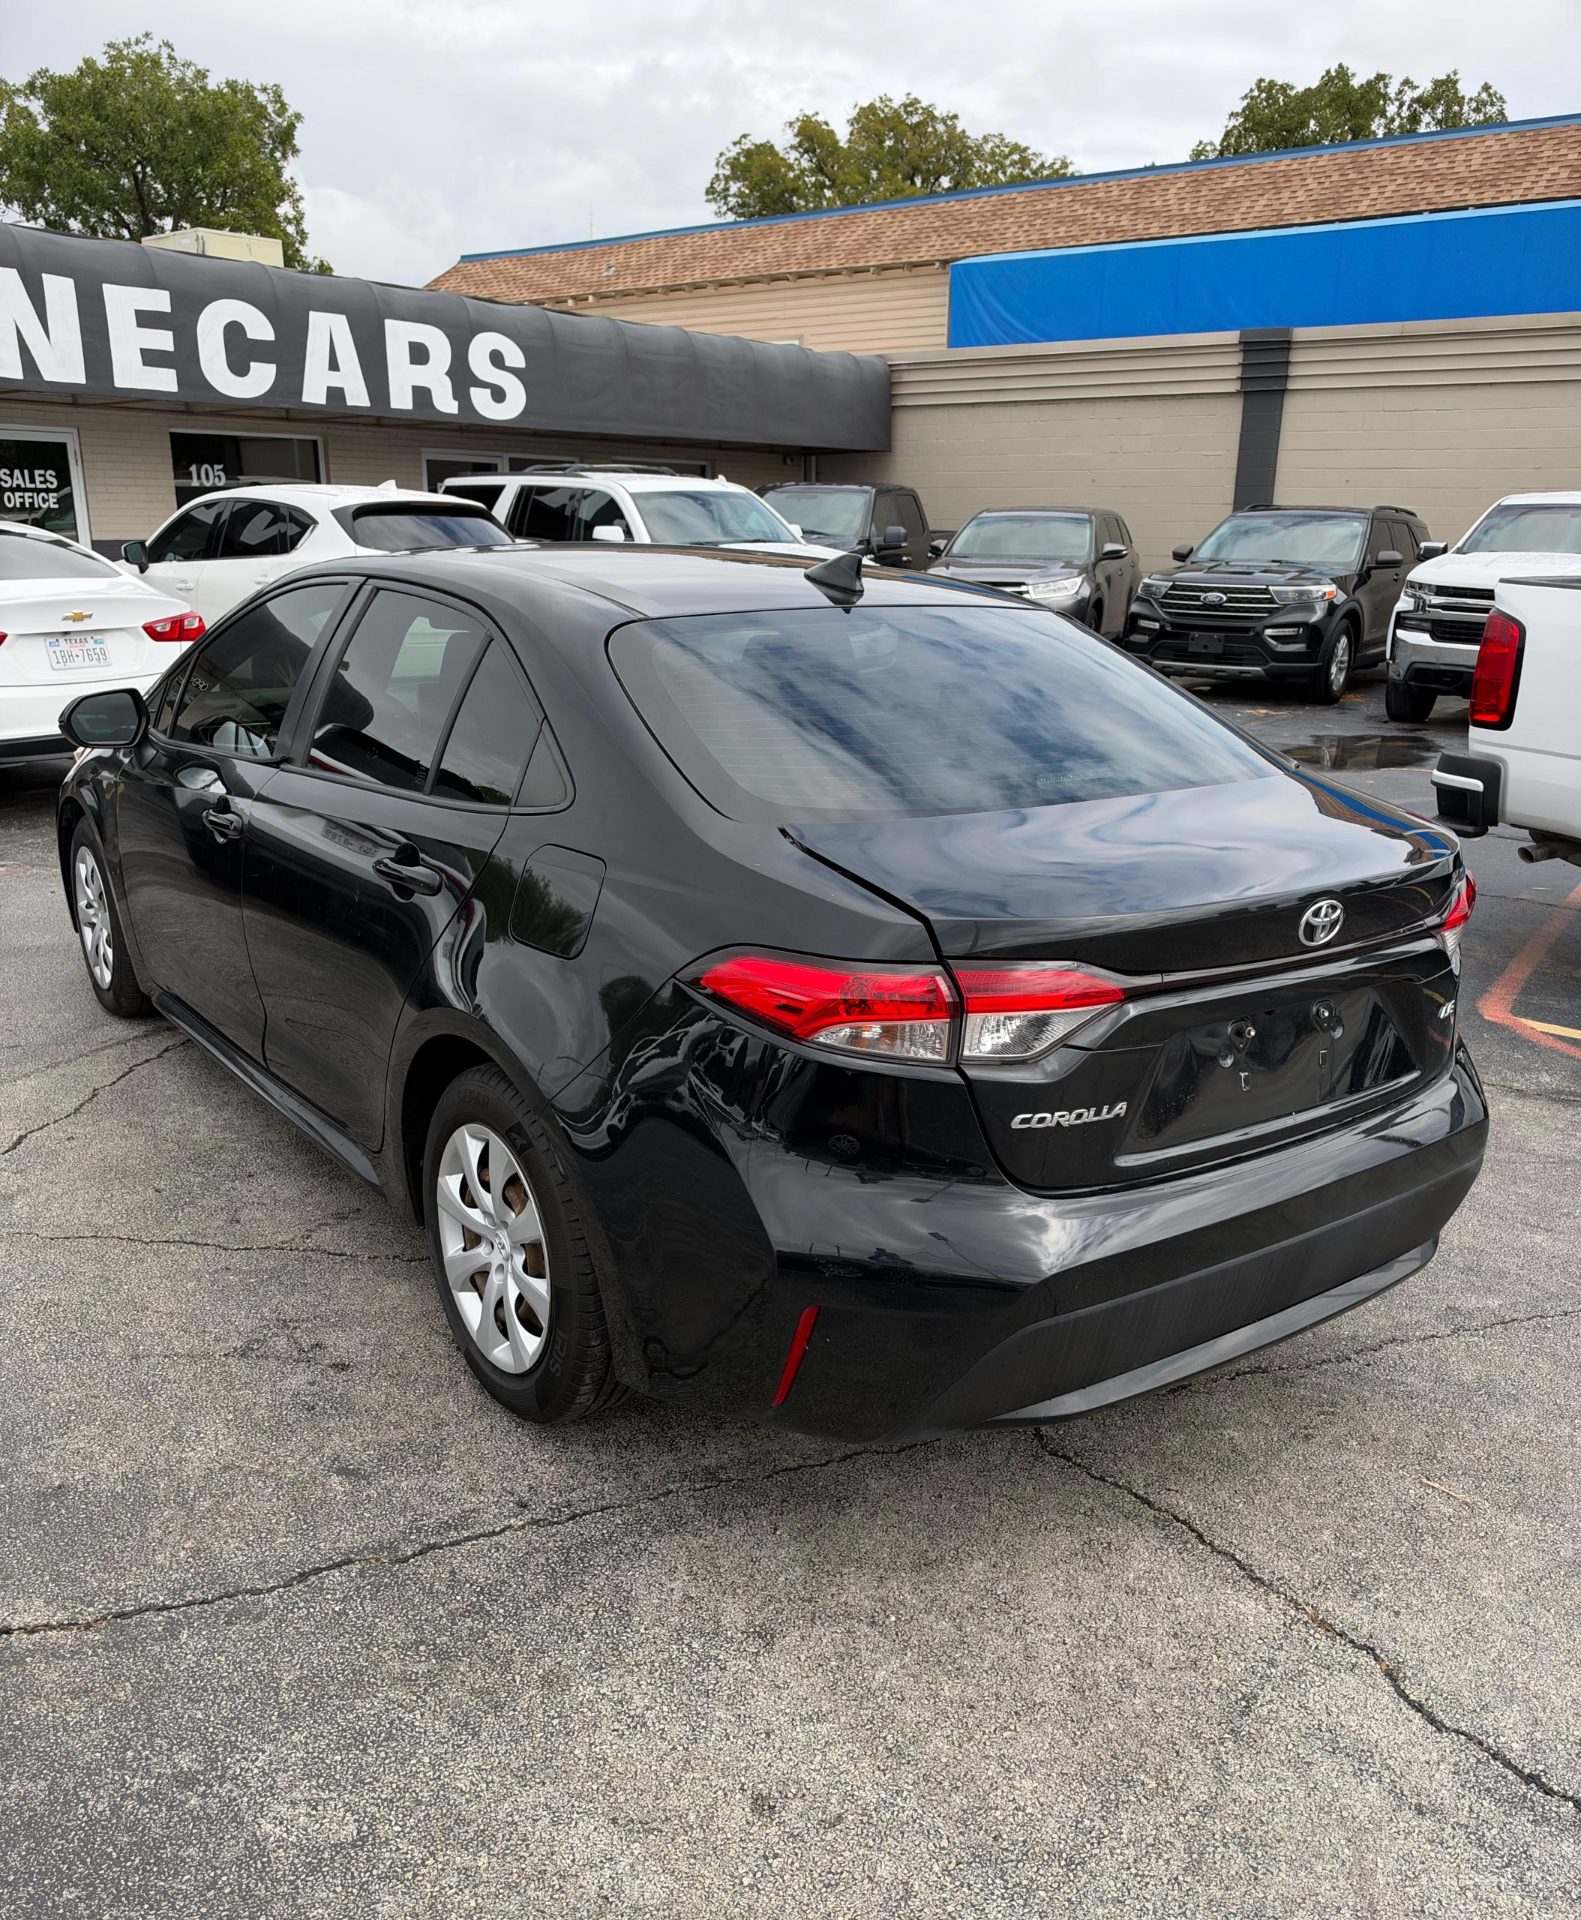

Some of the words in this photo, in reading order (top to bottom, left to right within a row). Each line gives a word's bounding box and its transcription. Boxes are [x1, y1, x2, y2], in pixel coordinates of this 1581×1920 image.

[0, 468, 58, 489] SALES
[189, 463, 226, 487] 105
[3, 492, 60, 509] OFFICE
[64, 637, 88, 645] TEXAS
[1437, 999, 1456, 1019] LE
[1010, 1101, 1127, 1129] COROLLA
